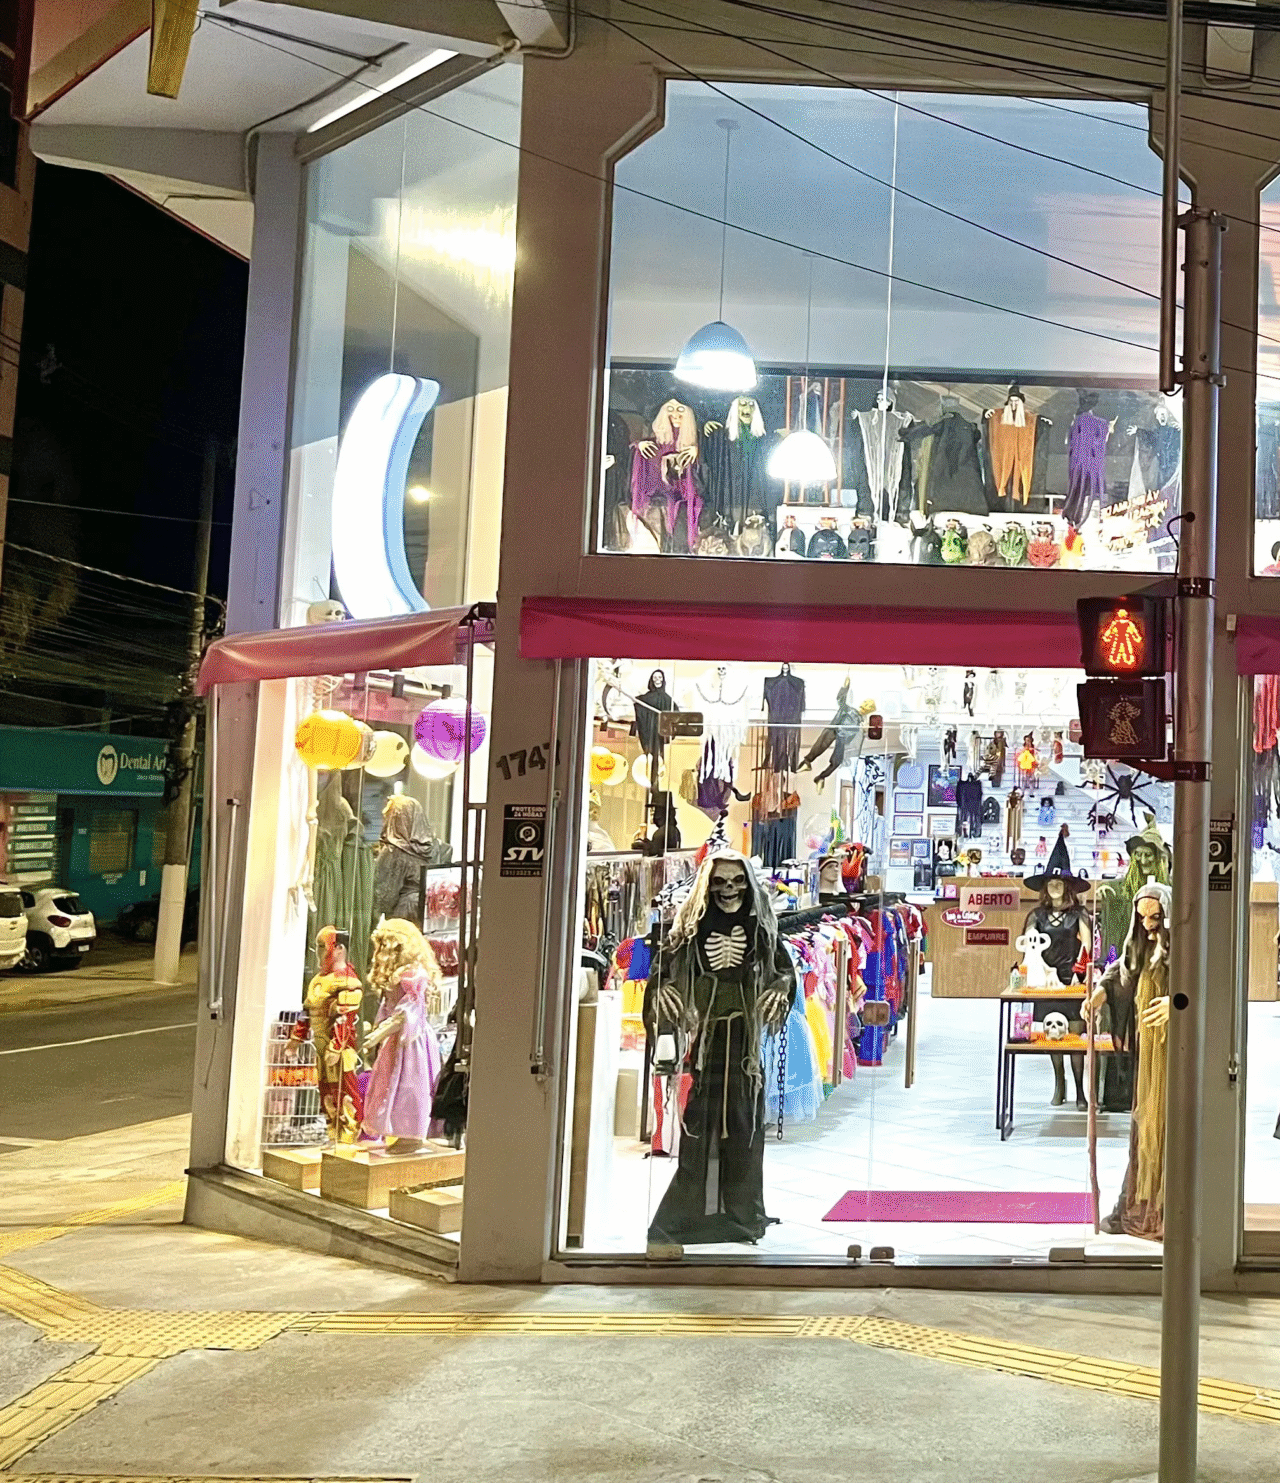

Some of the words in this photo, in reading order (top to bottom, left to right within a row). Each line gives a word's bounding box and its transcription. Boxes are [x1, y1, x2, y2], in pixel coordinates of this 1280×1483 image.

[120, 752, 151, 769] Dental
[503, 846, 544, 861] STV
[968, 893, 1013, 905] ABERTO
